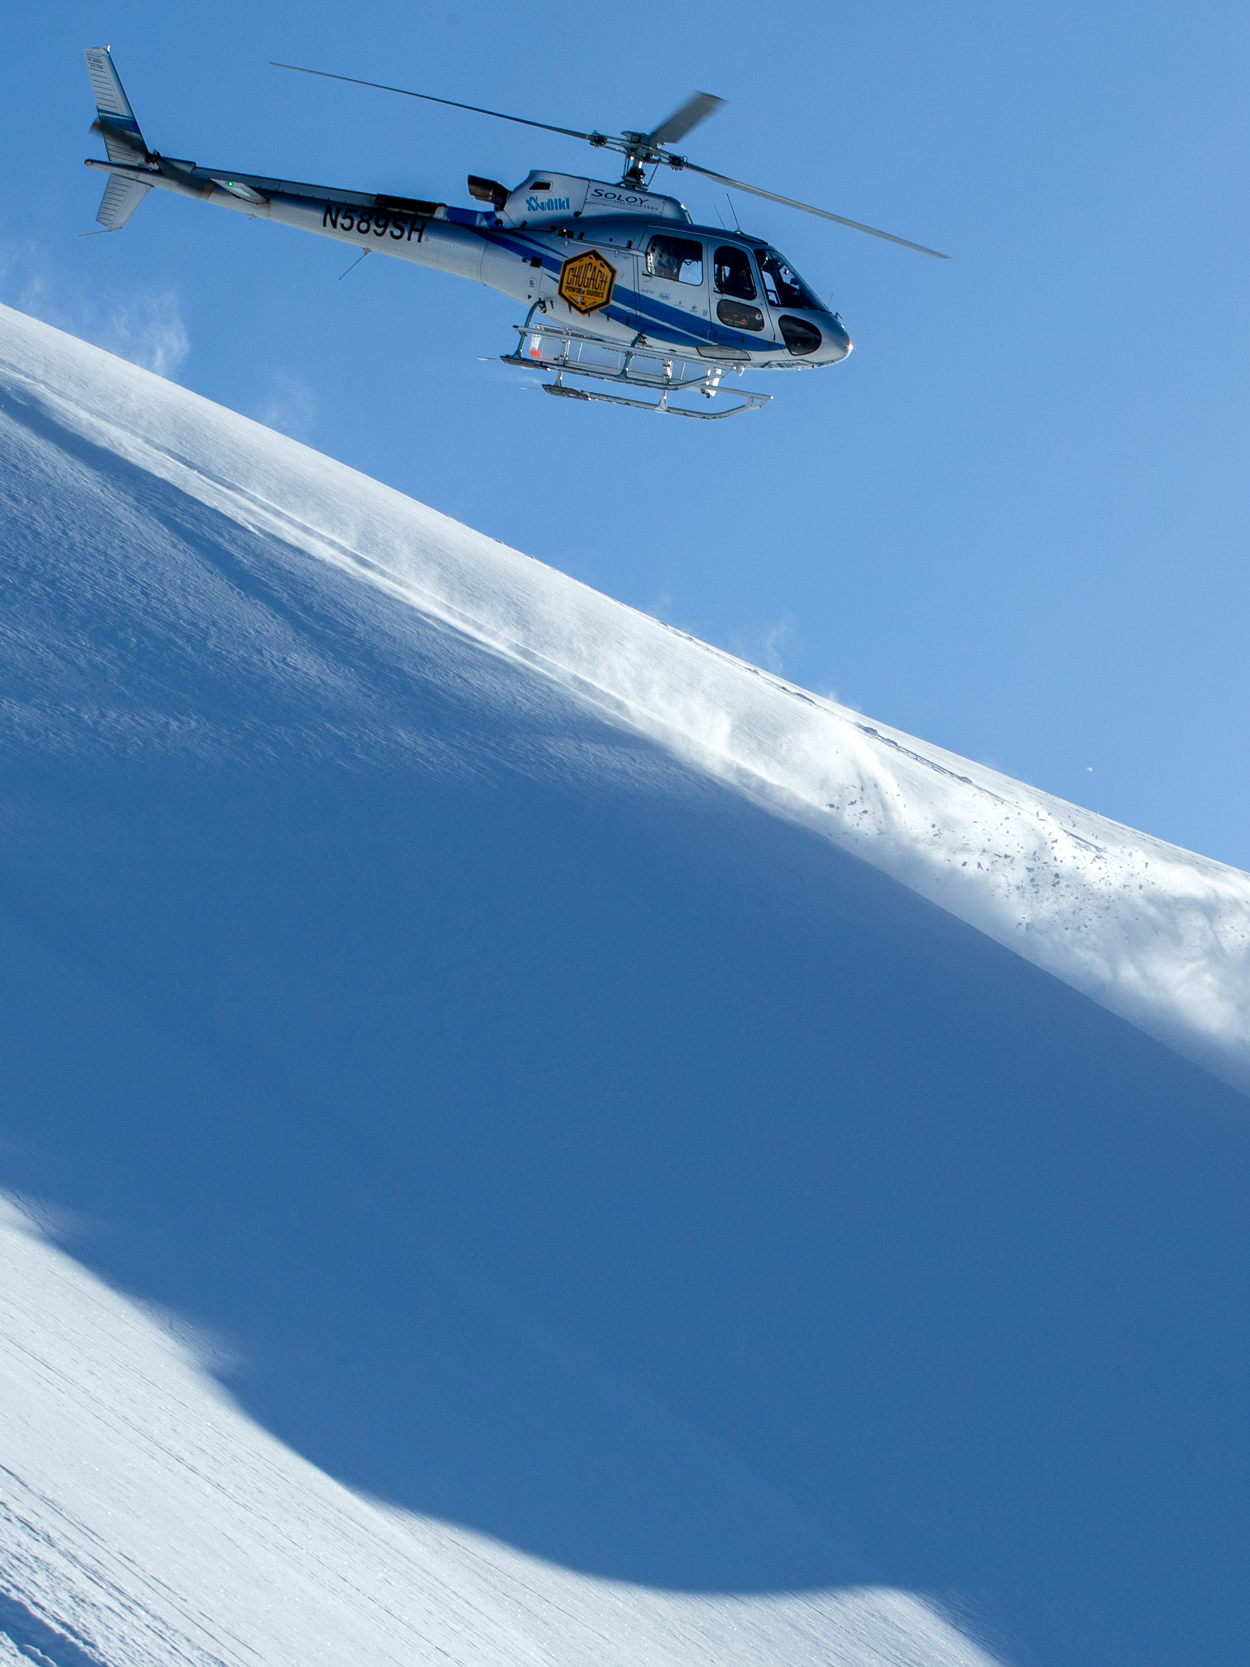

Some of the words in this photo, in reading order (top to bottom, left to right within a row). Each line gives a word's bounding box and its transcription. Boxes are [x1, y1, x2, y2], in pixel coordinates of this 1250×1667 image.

[590, 188, 649, 205] SOLOY
[613, 200, 659, 211] HELICOPTERS
[322, 204, 428, 243] N589SH
[566, 262, 608, 292] CHUGACH
[565, 285, 586, 296] POWDER
[586, 290, 605, 299] GUIDES
